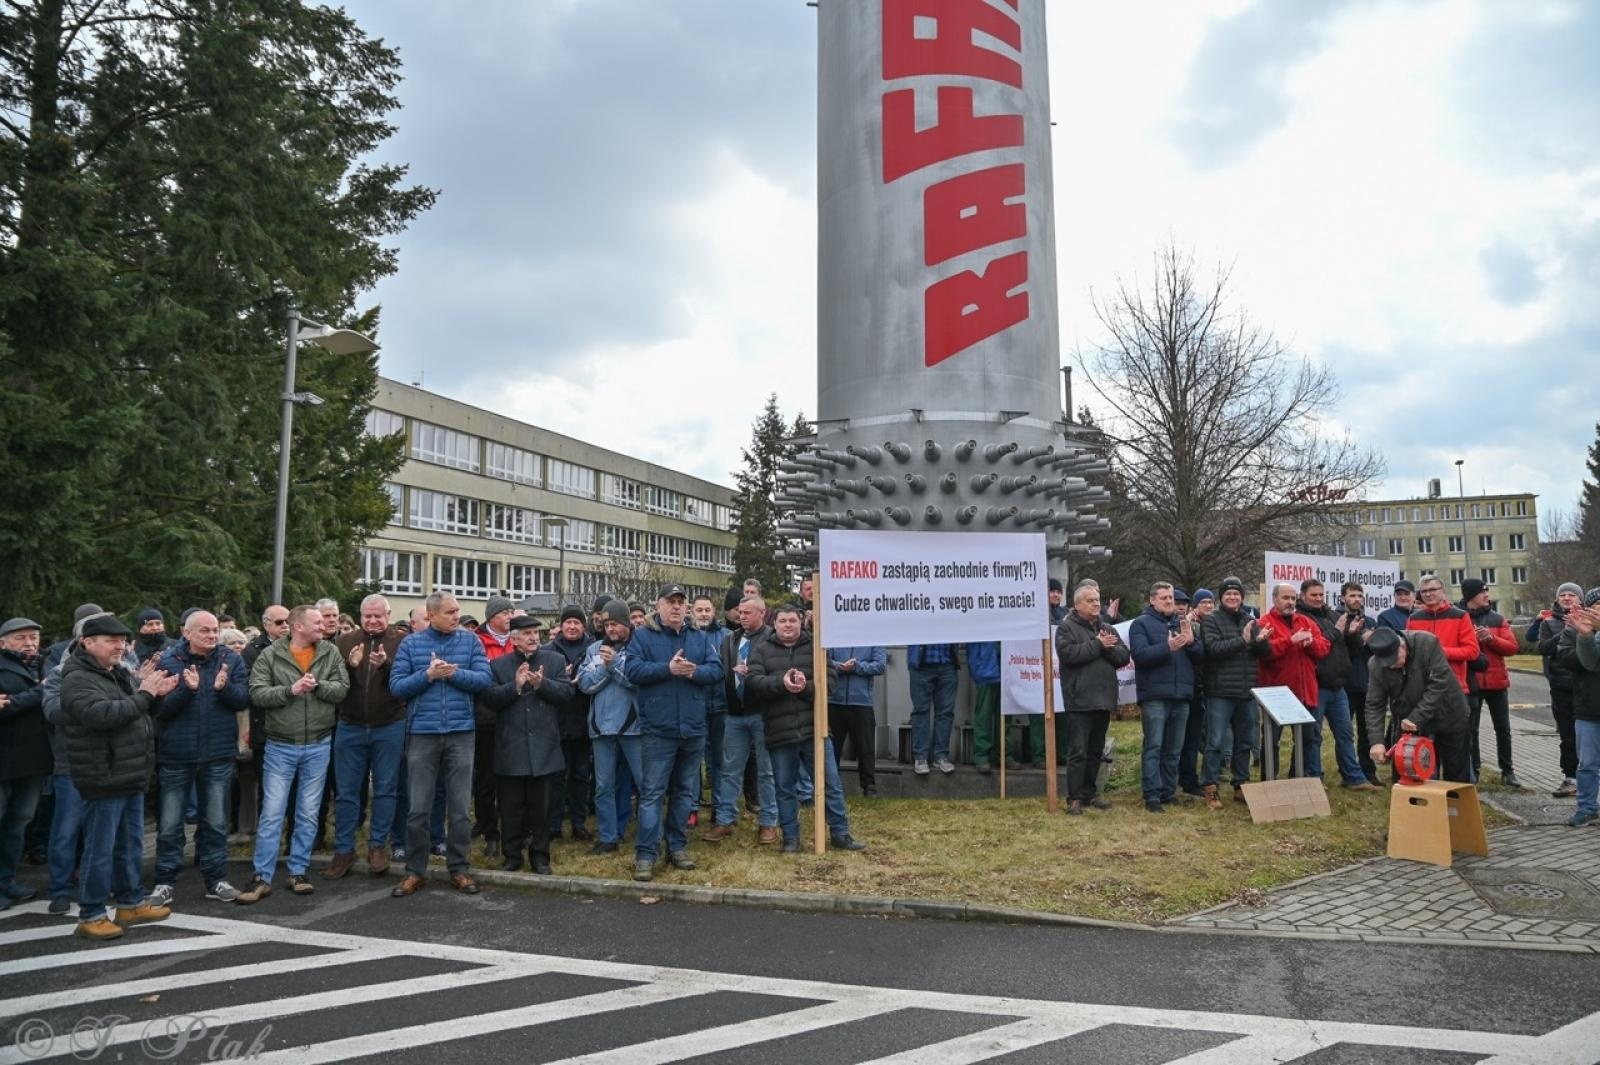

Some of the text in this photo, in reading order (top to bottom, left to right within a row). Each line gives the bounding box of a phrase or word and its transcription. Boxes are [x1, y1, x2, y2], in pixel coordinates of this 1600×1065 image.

[881, 0, 1029, 368] RAFA
[831, 560, 1037, 583] RAFAKO zastąpią zachodnie firmy(?!)
[1273, 564, 1395, 589] RAFAKO to nie ideologia!
[835, 591, 1035, 613] Cudze chwalicie, swego nie znacie!
